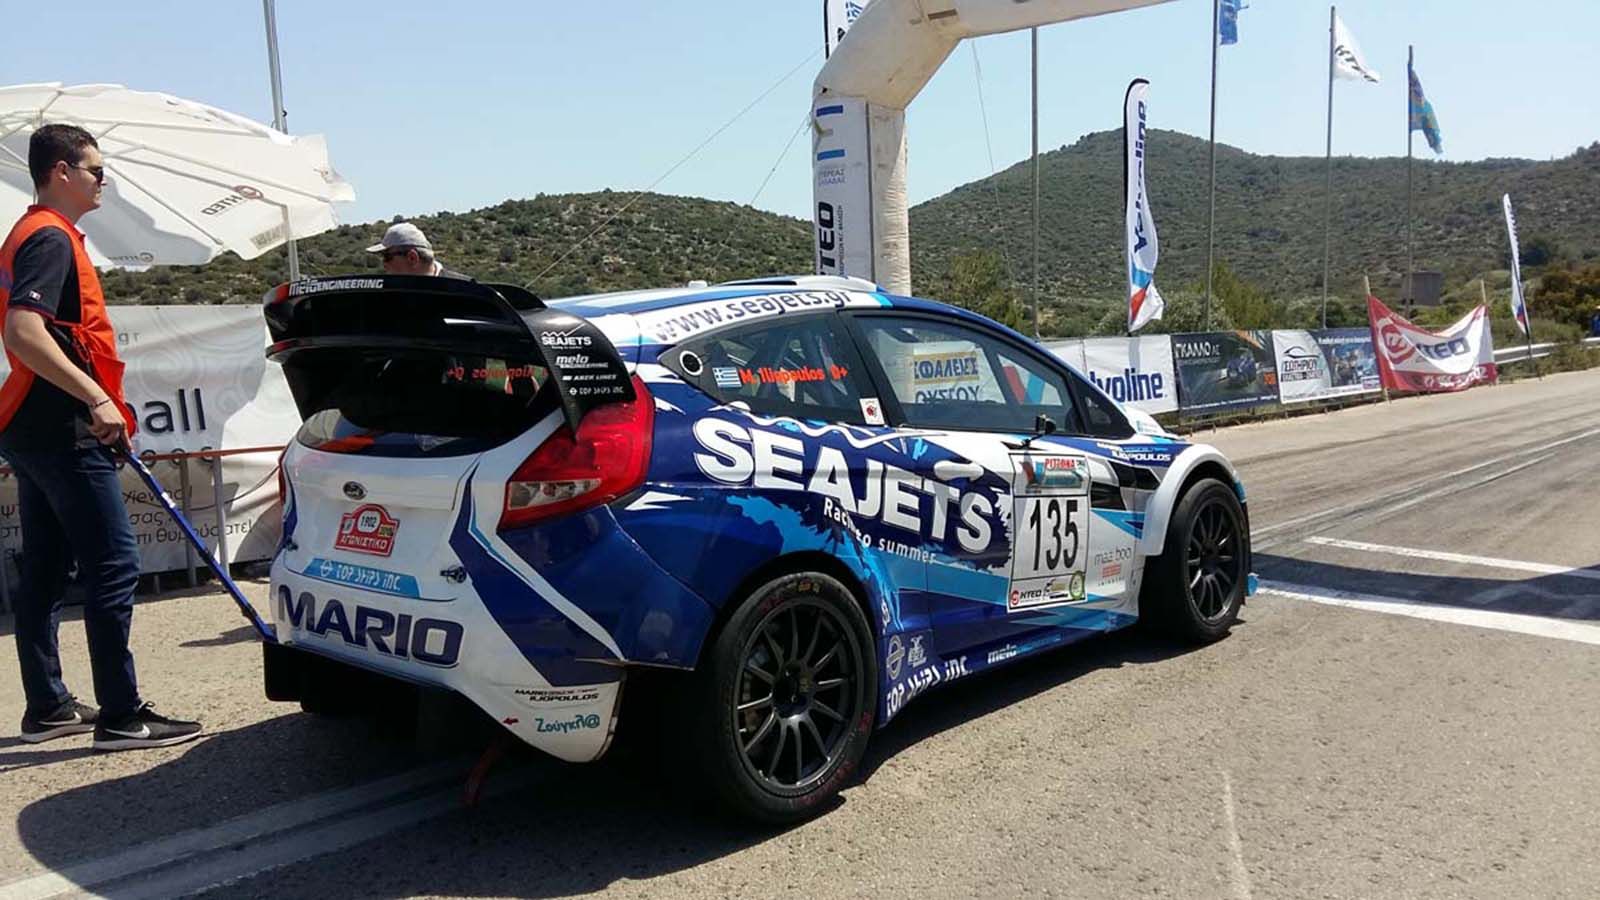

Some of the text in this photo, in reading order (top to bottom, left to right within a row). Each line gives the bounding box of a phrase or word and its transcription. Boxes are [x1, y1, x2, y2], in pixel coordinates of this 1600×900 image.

[1134, 100, 1149, 253] Valline
[541, 336, 592, 346] SEAJETS
[656, 288, 853, 342] www.seajets.gr
[693, 416, 993, 554] SEAJETS
[855, 528, 872, 548] to
[878, 538, 937, 564] summer
[1030, 498, 1079, 572] 135
[278, 584, 464, 668] MARIO
